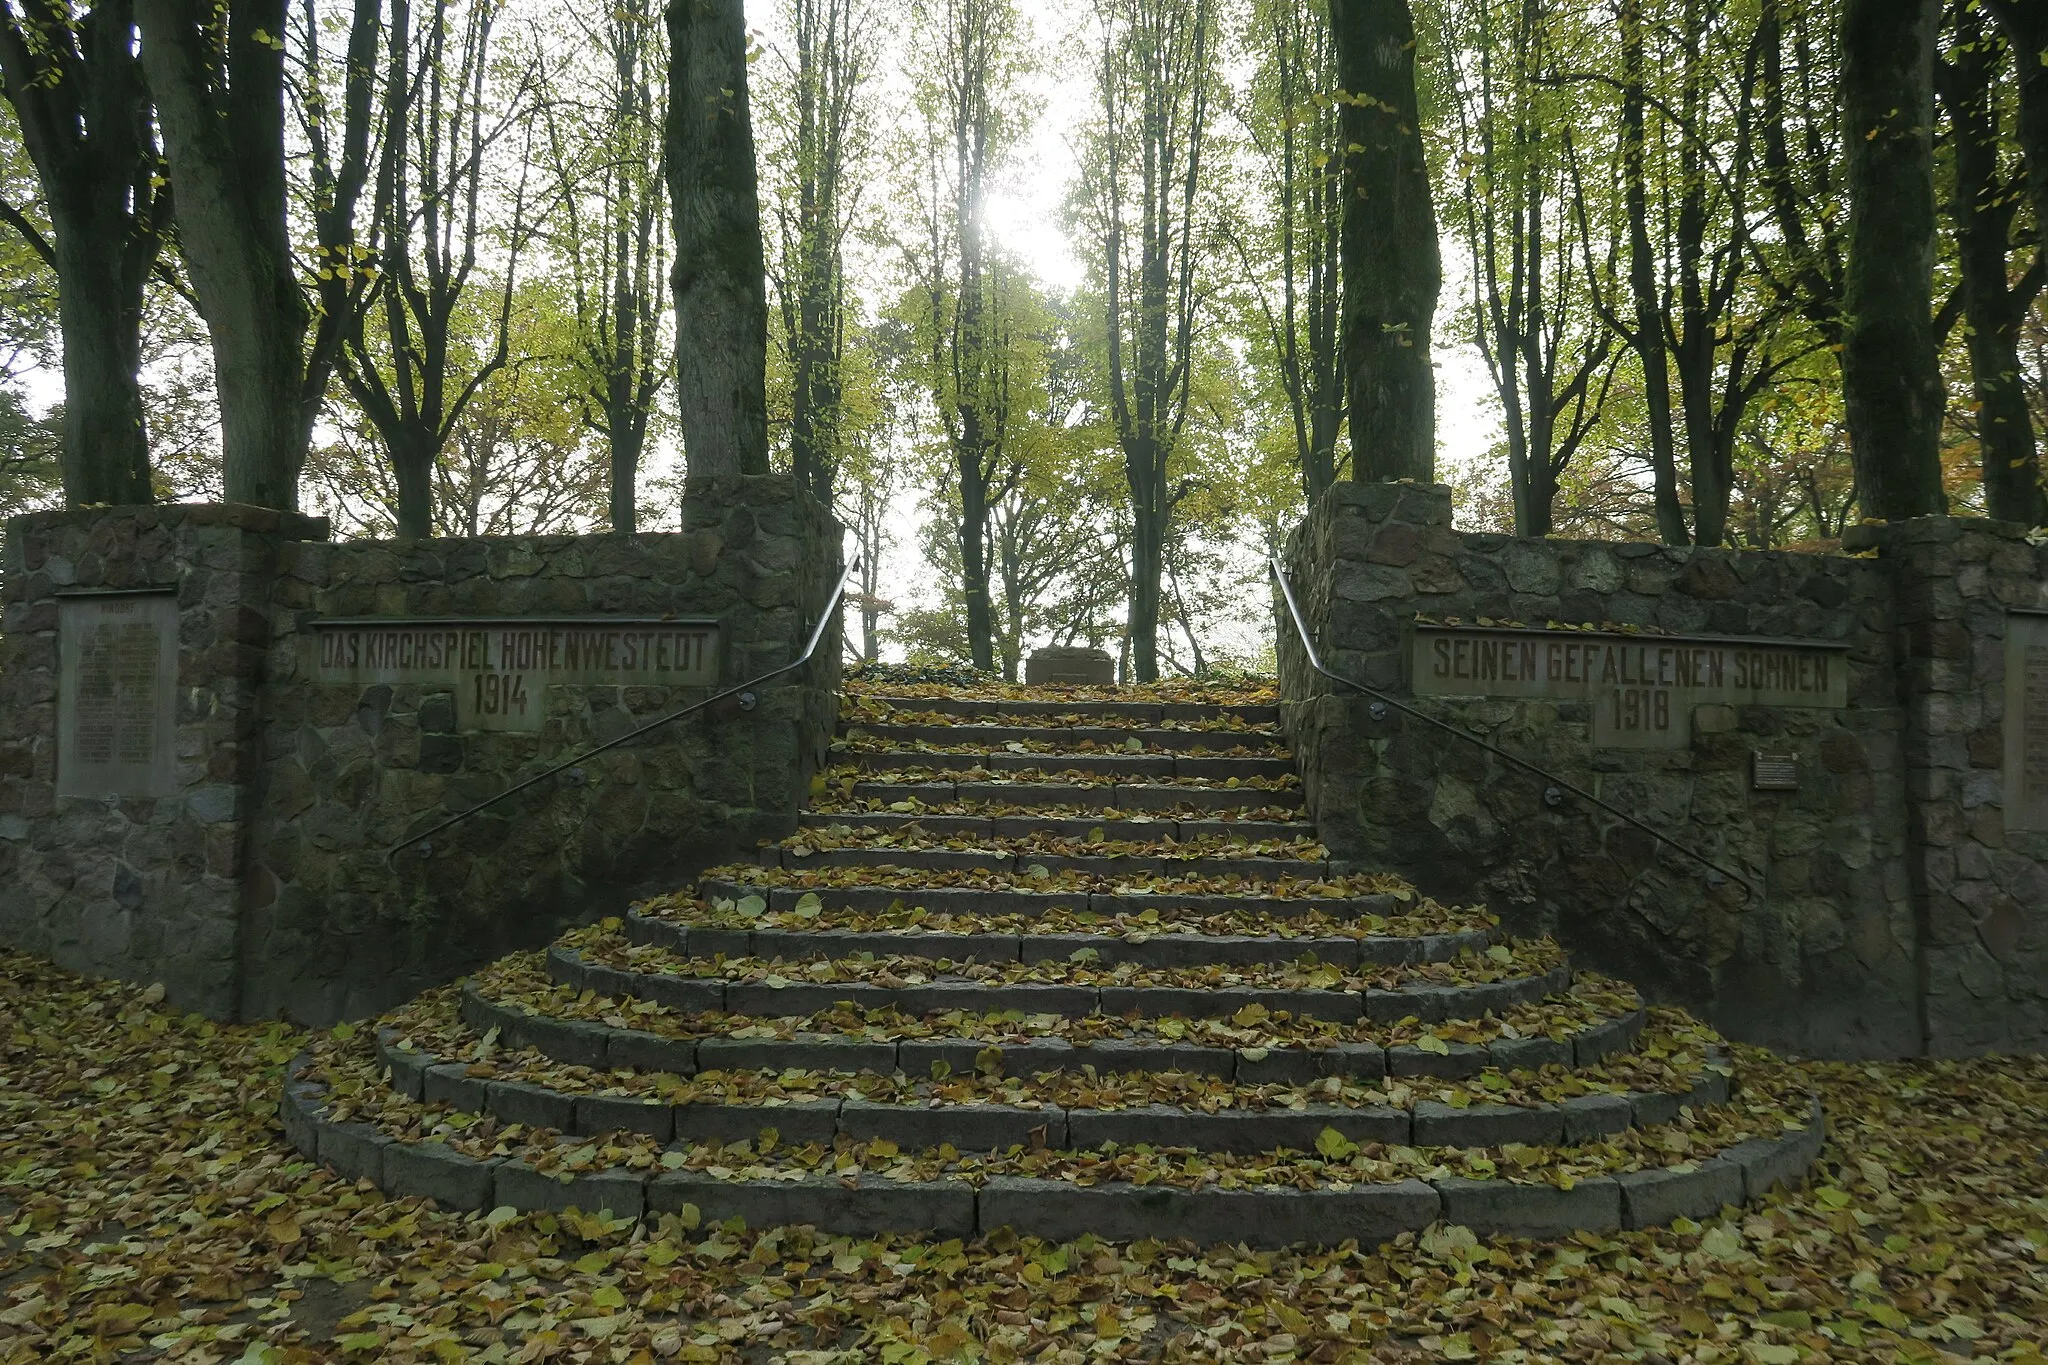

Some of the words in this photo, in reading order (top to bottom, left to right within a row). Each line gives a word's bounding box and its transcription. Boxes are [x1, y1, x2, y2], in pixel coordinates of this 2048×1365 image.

[320, 632, 360, 669] DAS
[365, 632, 494, 670] KIRCHSPIEL
[501, 631, 708, 672] HOHENWESTEDT
[1433, 638, 1537, 682] SEINEN
[1546, 643, 1724, 688] GEFALLENEN
[474, 673, 528, 715] 1914
[1611, 688, 1670, 731] 1918
